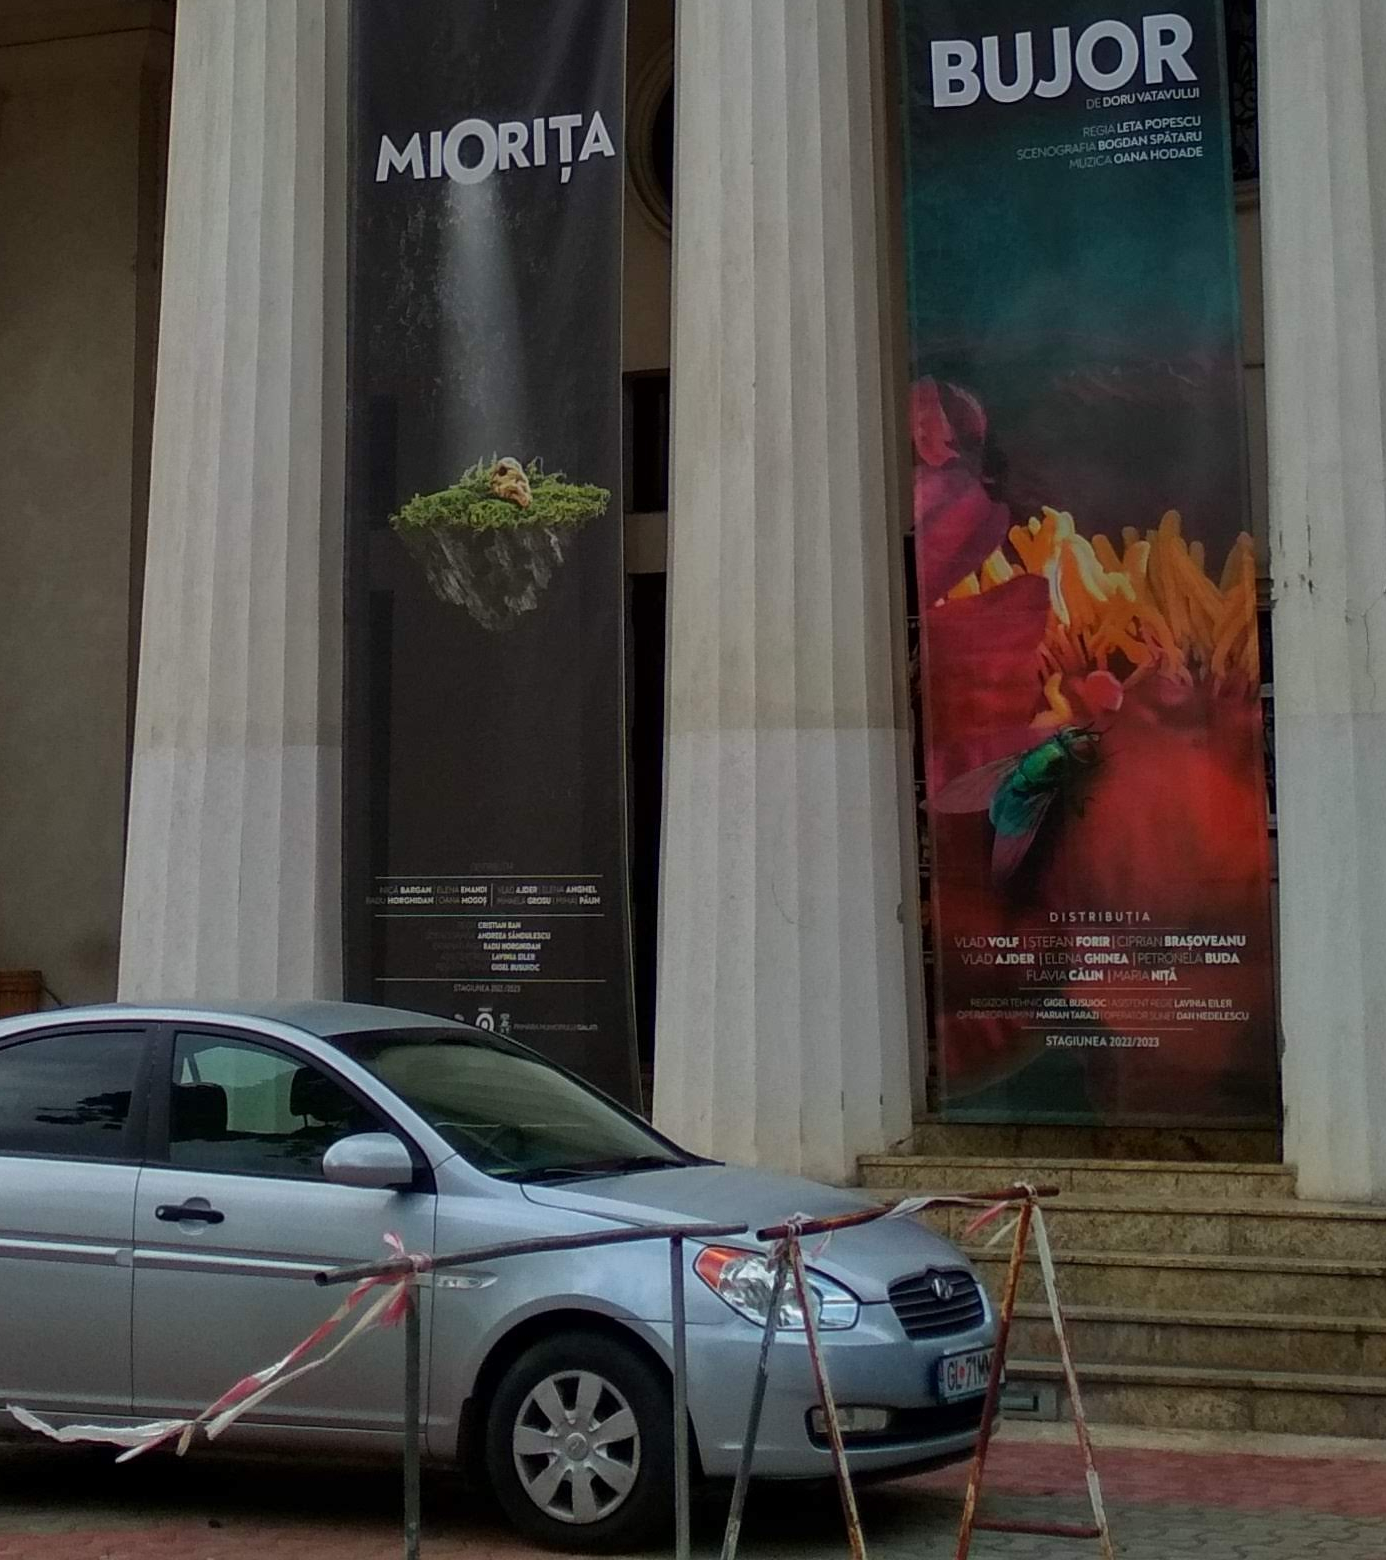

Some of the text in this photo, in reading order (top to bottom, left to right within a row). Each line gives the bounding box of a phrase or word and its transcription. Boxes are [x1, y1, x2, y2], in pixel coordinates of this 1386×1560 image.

[931, 13, 1197, 108] BUJOR
[1086, 97, 1101, 110] DE
[1102, 93, 1135, 108] DORU
[1083, 115, 1201, 138] REGIA LETA POPESCU
[374, 109, 616, 184] MIORIȚA
[1016, 130, 1203, 160] SCENOGRAFIA BOGDAN SPĂTARU
[1113, 151, 1148, 165] OANA
[1149, 146, 1203, 161] HODADE
[1049, 911, 1151, 924] DISTRIBUȚIA
[954, 936, 986, 948] VLAD
[988, 936, 1020, 948] VOLF
[1117, 936, 1163, 948] CIPRIAN
[1164, 935, 1247, 950] BRAȘOVEANU
[961, 953, 994, 965] VLAD
[995, 953, 1035, 965] AJDER
[1045, 953, 1082, 965] ELENA
[1084, 953, 1129, 965] GHINEA
[1204, 952, 1241, 964] BUDA
[1026, 969, 1067, 982] FLAVIA
[1068, 967, 1103, 981] CĂLIN
[1151, 967, 1178, 985] NIȚĂ
[1045, 1035, 1107, 1047] STAGIUNEA
